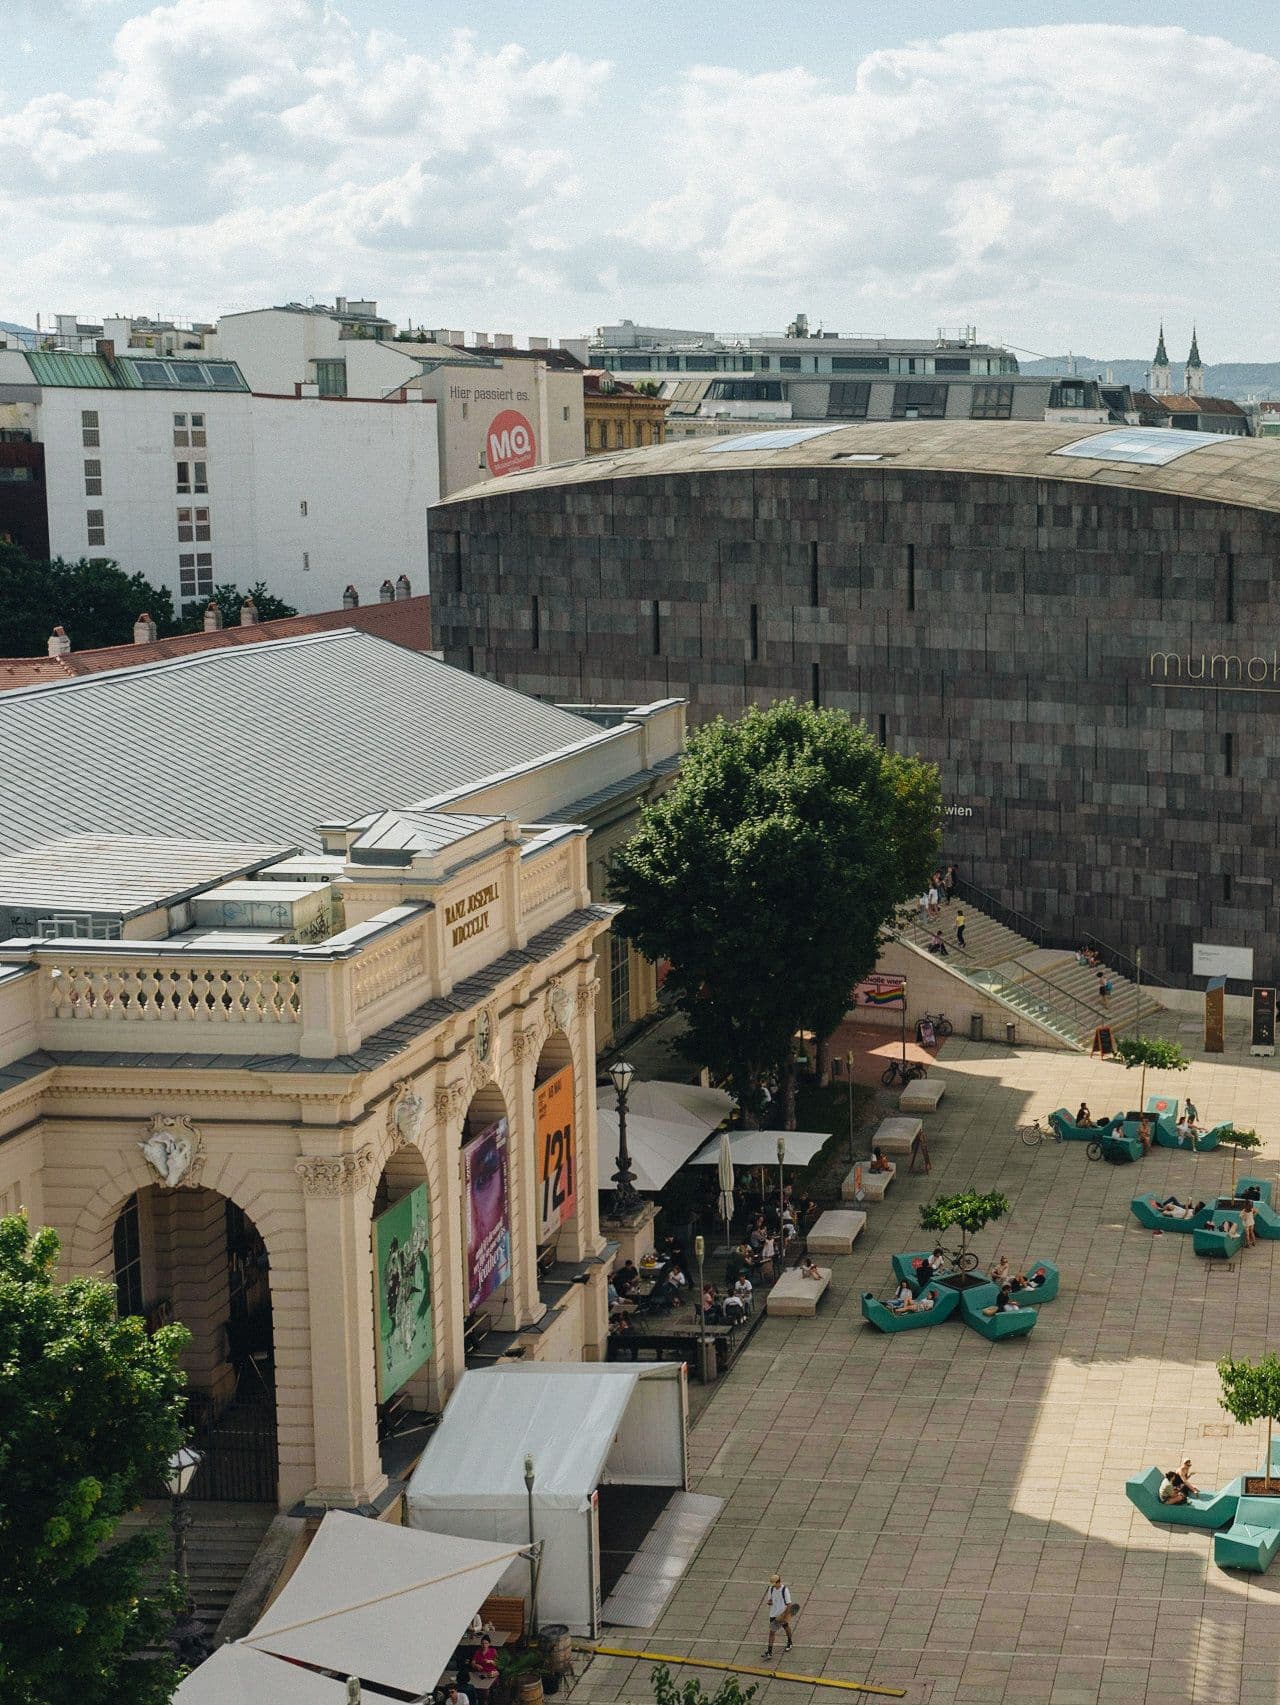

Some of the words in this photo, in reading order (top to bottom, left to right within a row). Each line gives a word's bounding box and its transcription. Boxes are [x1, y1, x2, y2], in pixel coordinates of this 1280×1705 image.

[450, 386, 472, 399] Hier
[474, 388, 514, 402] passiert
[516, 391, 530, 401] es.
[490, 425, 531, 463] MQ
[944, 803, 973, 817] wien
